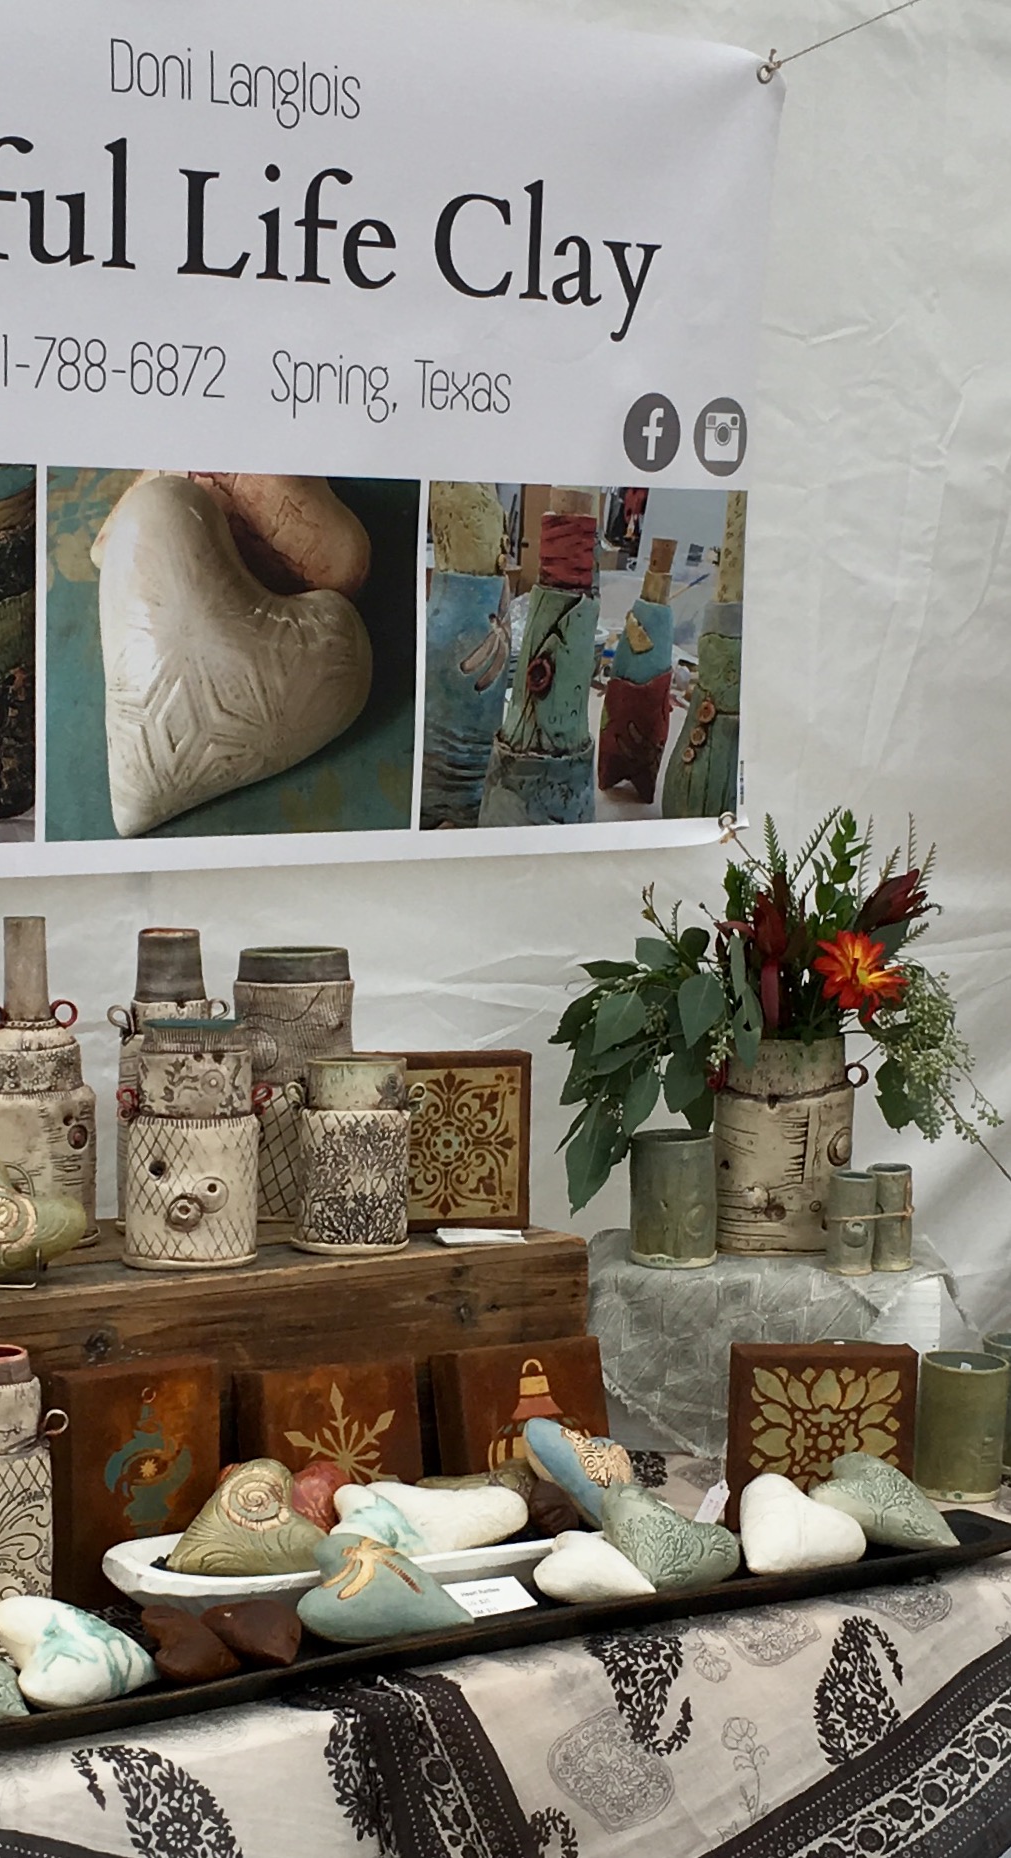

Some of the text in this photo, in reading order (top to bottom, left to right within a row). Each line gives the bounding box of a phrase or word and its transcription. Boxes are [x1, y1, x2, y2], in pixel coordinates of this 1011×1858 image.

[110, 37, 362, 129] Doni Langlois
[176, 163, 397, 290] Life
[434, 179, 663, 343] Clay
[270, 349, 398, 424] Spring,
[413, 358, 512, 415] Texas
